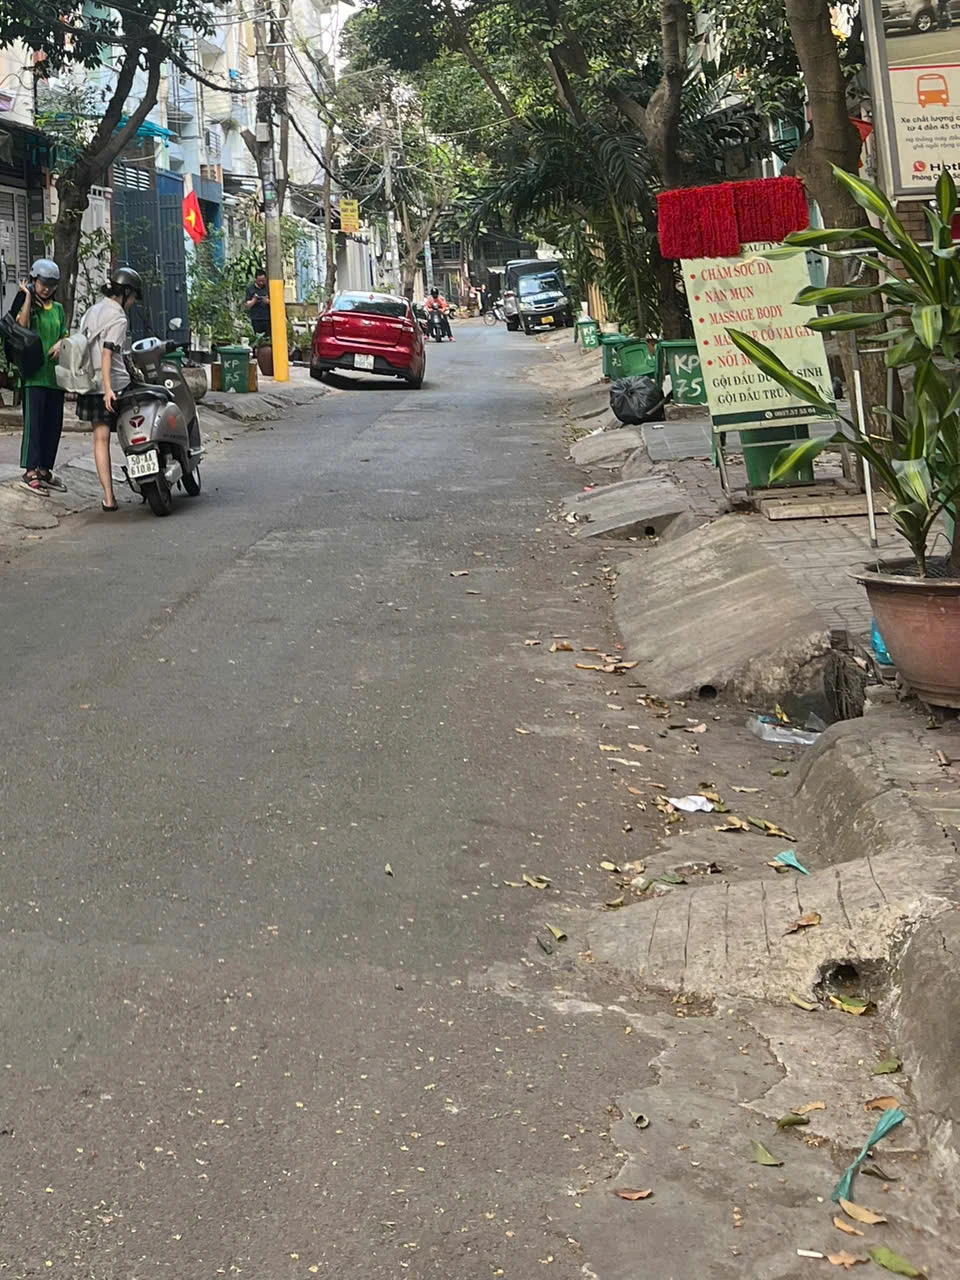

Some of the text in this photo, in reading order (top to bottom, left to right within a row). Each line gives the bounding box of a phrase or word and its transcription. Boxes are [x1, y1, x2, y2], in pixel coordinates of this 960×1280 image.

[740, 241, 774, 253] EAUTY
[757, 262, 773, 275] DA
[729, 285, 754, 302] MỤN
[708, 304, 783, 325] MASSAGE BODY
[583, 326, 595, 336] KP
[776, 326, 794, 339] VAI
[224, 359, 240, 368] KP
[674, 354, 700, 375] KP
[797, 367, 823, 378] SINH
[675, 377, 703, 398] 75
